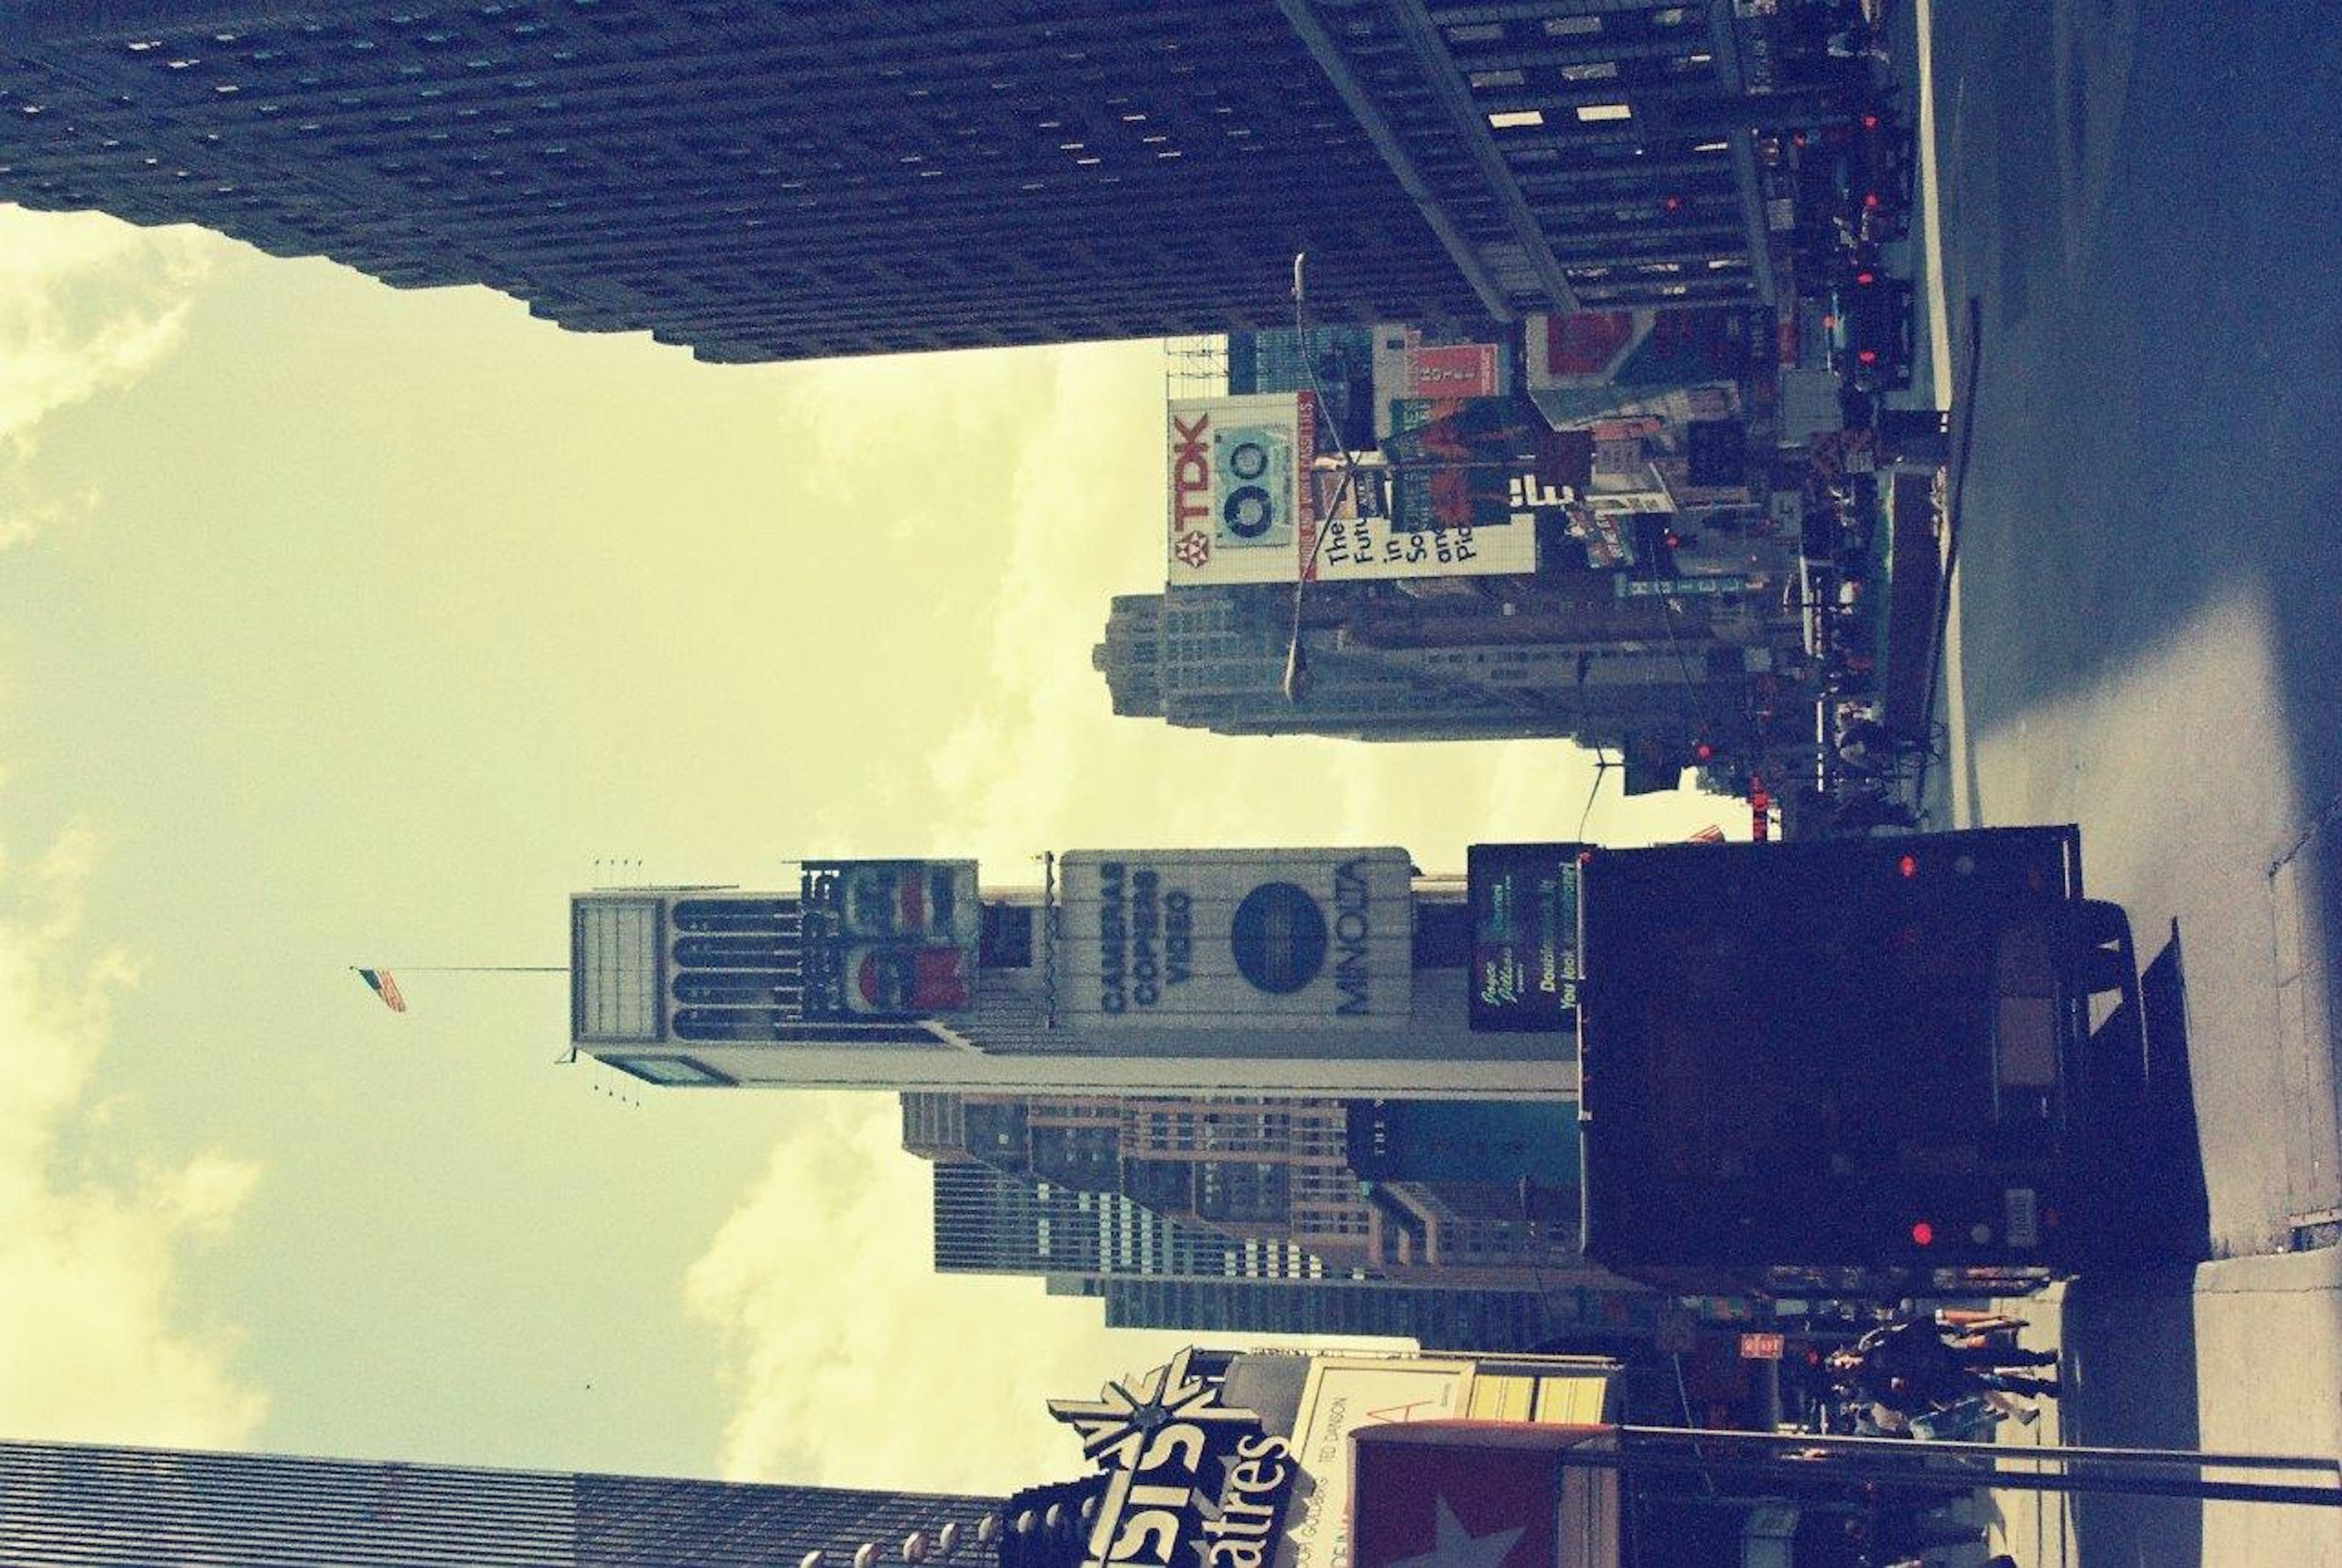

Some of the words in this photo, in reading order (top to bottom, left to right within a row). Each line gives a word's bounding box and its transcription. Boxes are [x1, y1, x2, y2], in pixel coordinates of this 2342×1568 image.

[1173, 413, 1209, 532] TDK
[1325, 522, 1349, 566] The
[1384, 540, 1402, 563] in
[1100, 862, 1125, 1013] CAMERAS
[1132, 872, 1158, 1005] COPIERS
[1164, 890, 1191, 986] VIDEO
[1334, 856, 1368, 1016] MINOLTA
[1560, 948, 1576, 981] look
[1560, 983, 1576, 1009] You
[1323, 1397, 1347, 1442] DANSON
[1317, 1447, 1336, 1463] TED
